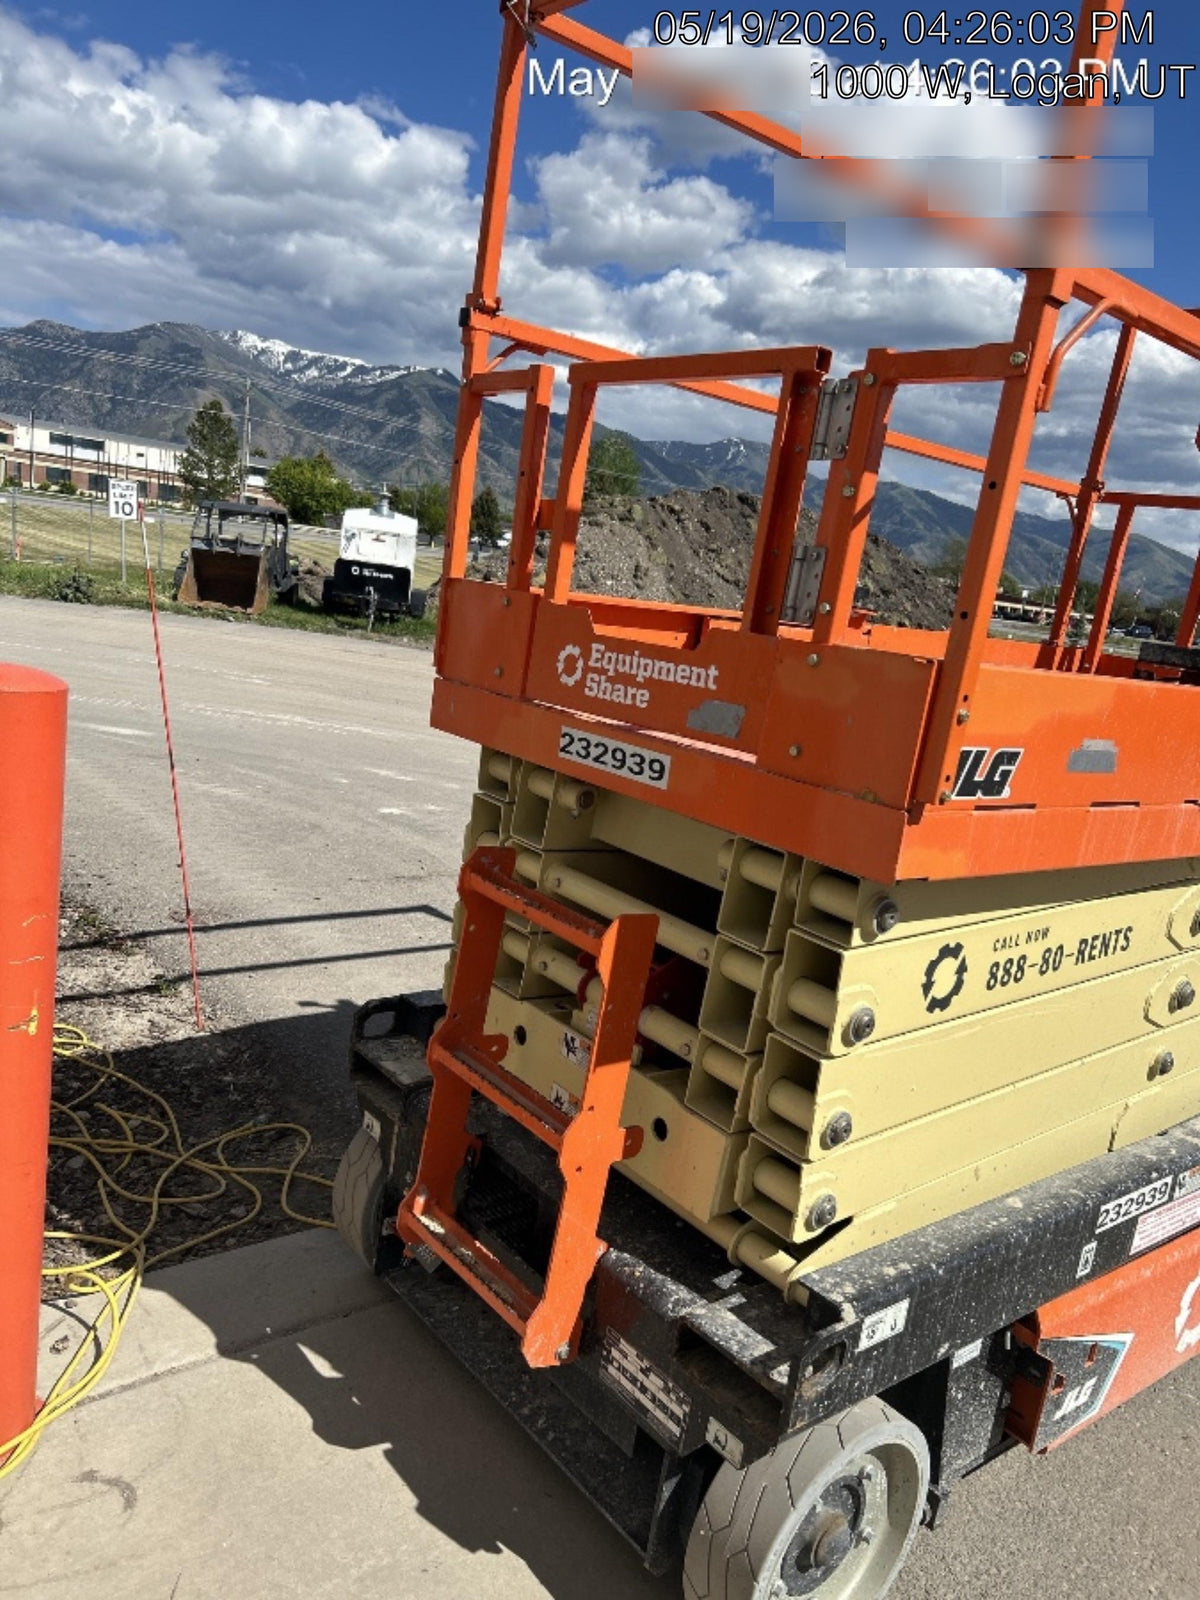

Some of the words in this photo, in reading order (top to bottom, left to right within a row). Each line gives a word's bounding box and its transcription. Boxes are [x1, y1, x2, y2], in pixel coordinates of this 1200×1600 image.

[114, 500, 134, 516] 10
[588, 642, 719, 691] Equipment
[584, 673, 650, 709] Share
[559, 731, 667, 783] 232939
[986, 925, 1133, 991] 888-80-RENTS
[993, 933, 1020, 952] CALL
[1025, 926, 1050, 945] NOW
[1096, 1181, 1170, 1228] 232939
